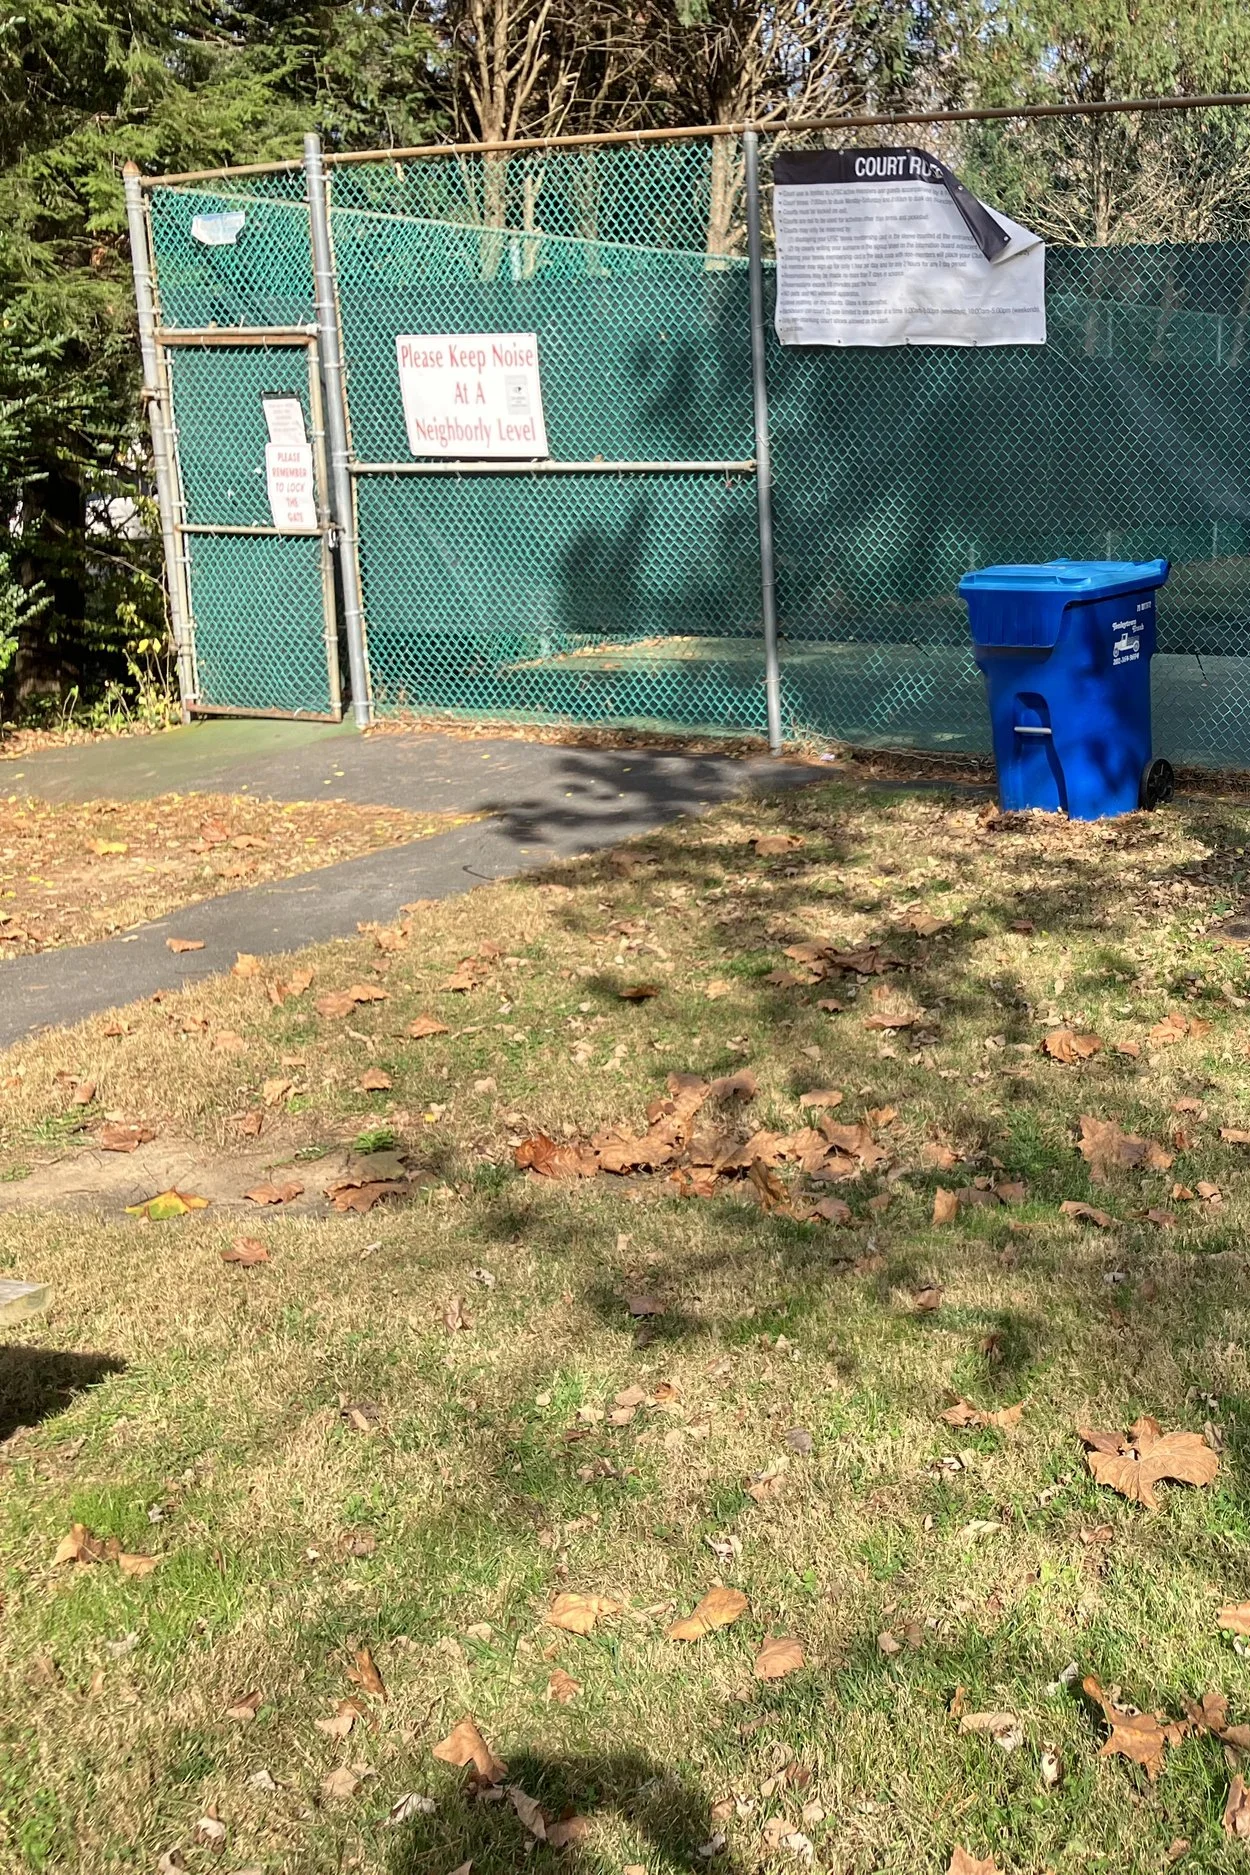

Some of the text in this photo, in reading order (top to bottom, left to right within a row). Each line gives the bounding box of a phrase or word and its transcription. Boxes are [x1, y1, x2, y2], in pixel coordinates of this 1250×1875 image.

[855, 156, 944, 179] COURT RUS
[401, 342, 534, 375] Please Keep Noise
[454, 381, 469, 405] At
[475, 382, 486, 404] A
[415, 417, 537, 449] Neighborly Level
[277, 452, 300, 462] PLEASE
[272, 467, 307, 477] REMEMBER
[275, 482, 305, 493] TO LOCK
[286, 497, 299, 508] THE
[287, 512, 304, 523] GATE
